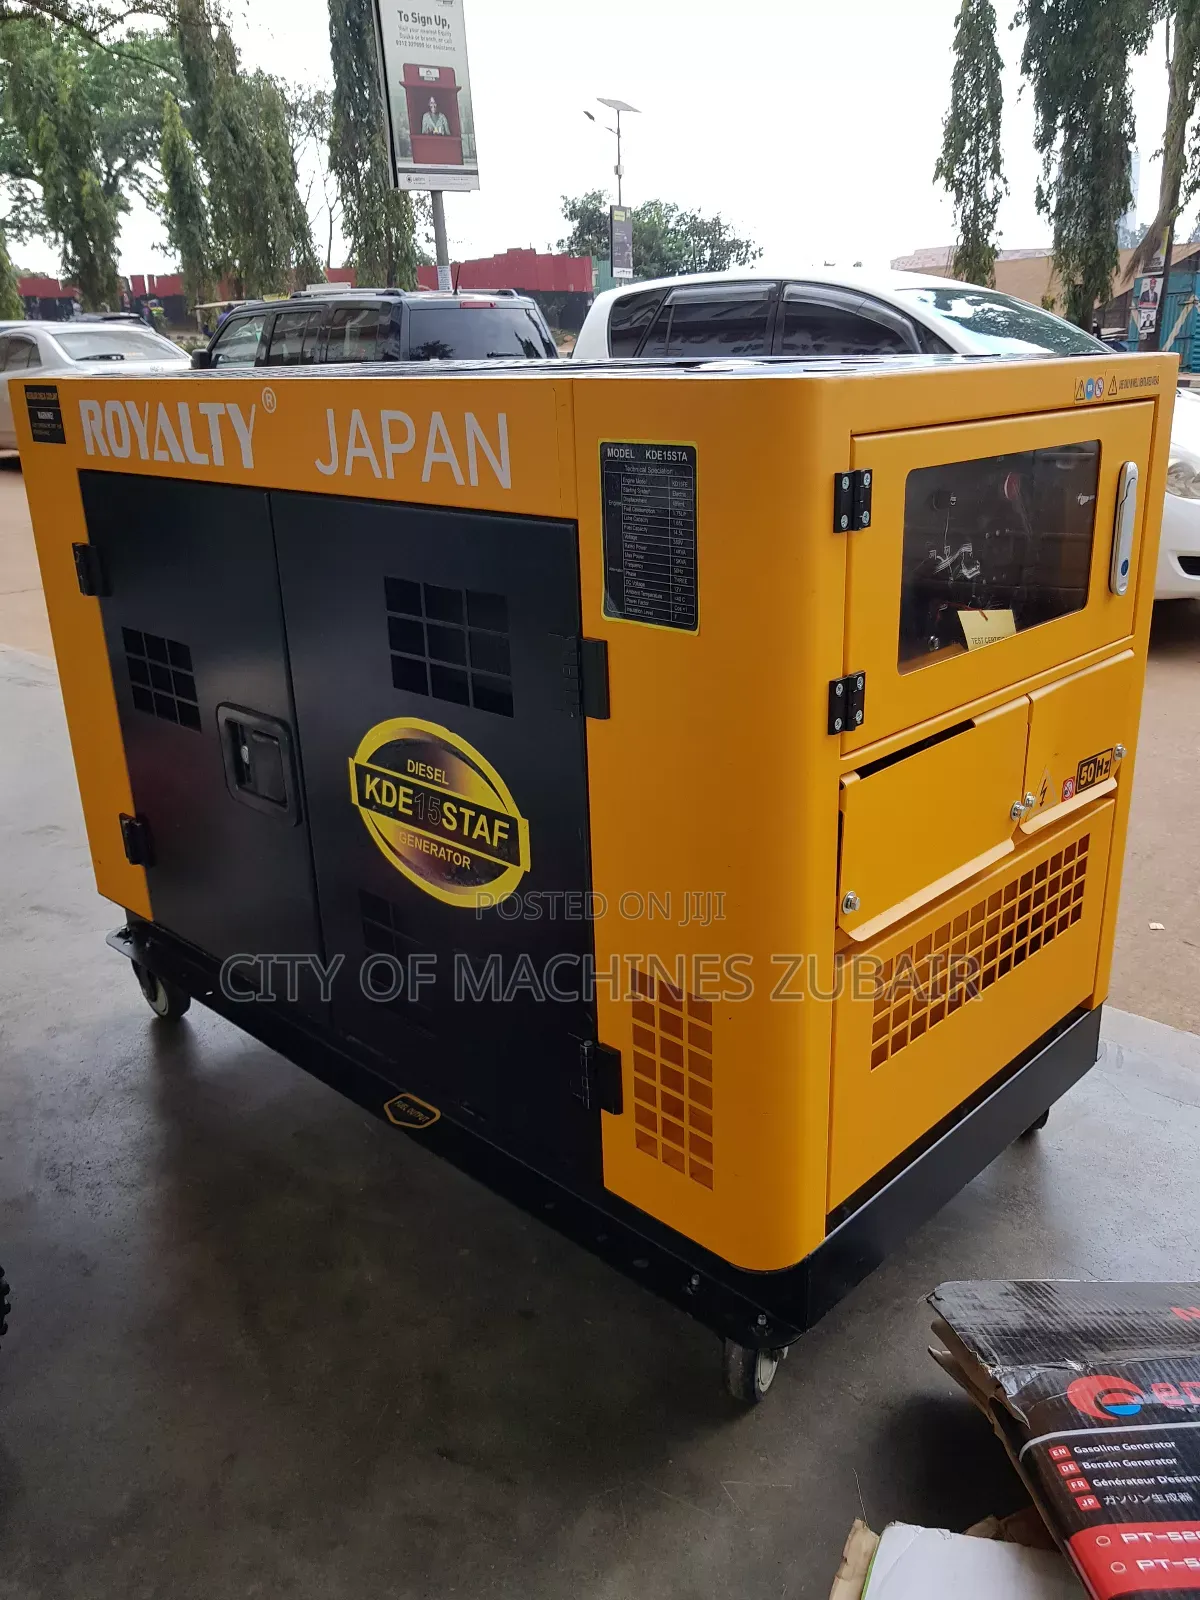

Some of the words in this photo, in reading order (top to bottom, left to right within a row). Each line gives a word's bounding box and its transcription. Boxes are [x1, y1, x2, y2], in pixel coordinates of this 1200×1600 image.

[397, 9, 409, 23] To
[411, 12, 433, 27] Sign
[434, 15, 451, 29] Up,
[78, 399, 256, 469] ROYALTY
[314, 408, 512, 489] JAPAN
[607, 448, 635, 459] MODEL
[645, 450, 688, 462] KDE15STA
[625, 464, 646, 473] Technical
[623, 477, 635, 485] Engine
[632, 526, 648, 534] Capacity
[625, 561, 644, 569] Frequency
[641, 590, 663, 600] Temperature
[643, 607, 654, 616] Level
[971, 636, 984, 645] TEST
[407, 759, 449, 785] DIESEL
[365, 773, 510, 848] KDE15STAF
[399, 831, 471, 870] GENERATOR
[1052, 1448, 1067, 1457] EN
[1074, 1444, 1121, 1454] Gasoline
[1122, 1440, 1176, 1451] Generator
[1061, 1463, 1076, 1472] DE
[1082, 1458, 1121, 1470] Benzin
[1122, 1456, 1177, 1468] Generator
[1071, 1480, 1085, 1490] FR
[1092, 1476, 1156, 1488] Générateur
[1081, 1498, 1095, 1508] JP
